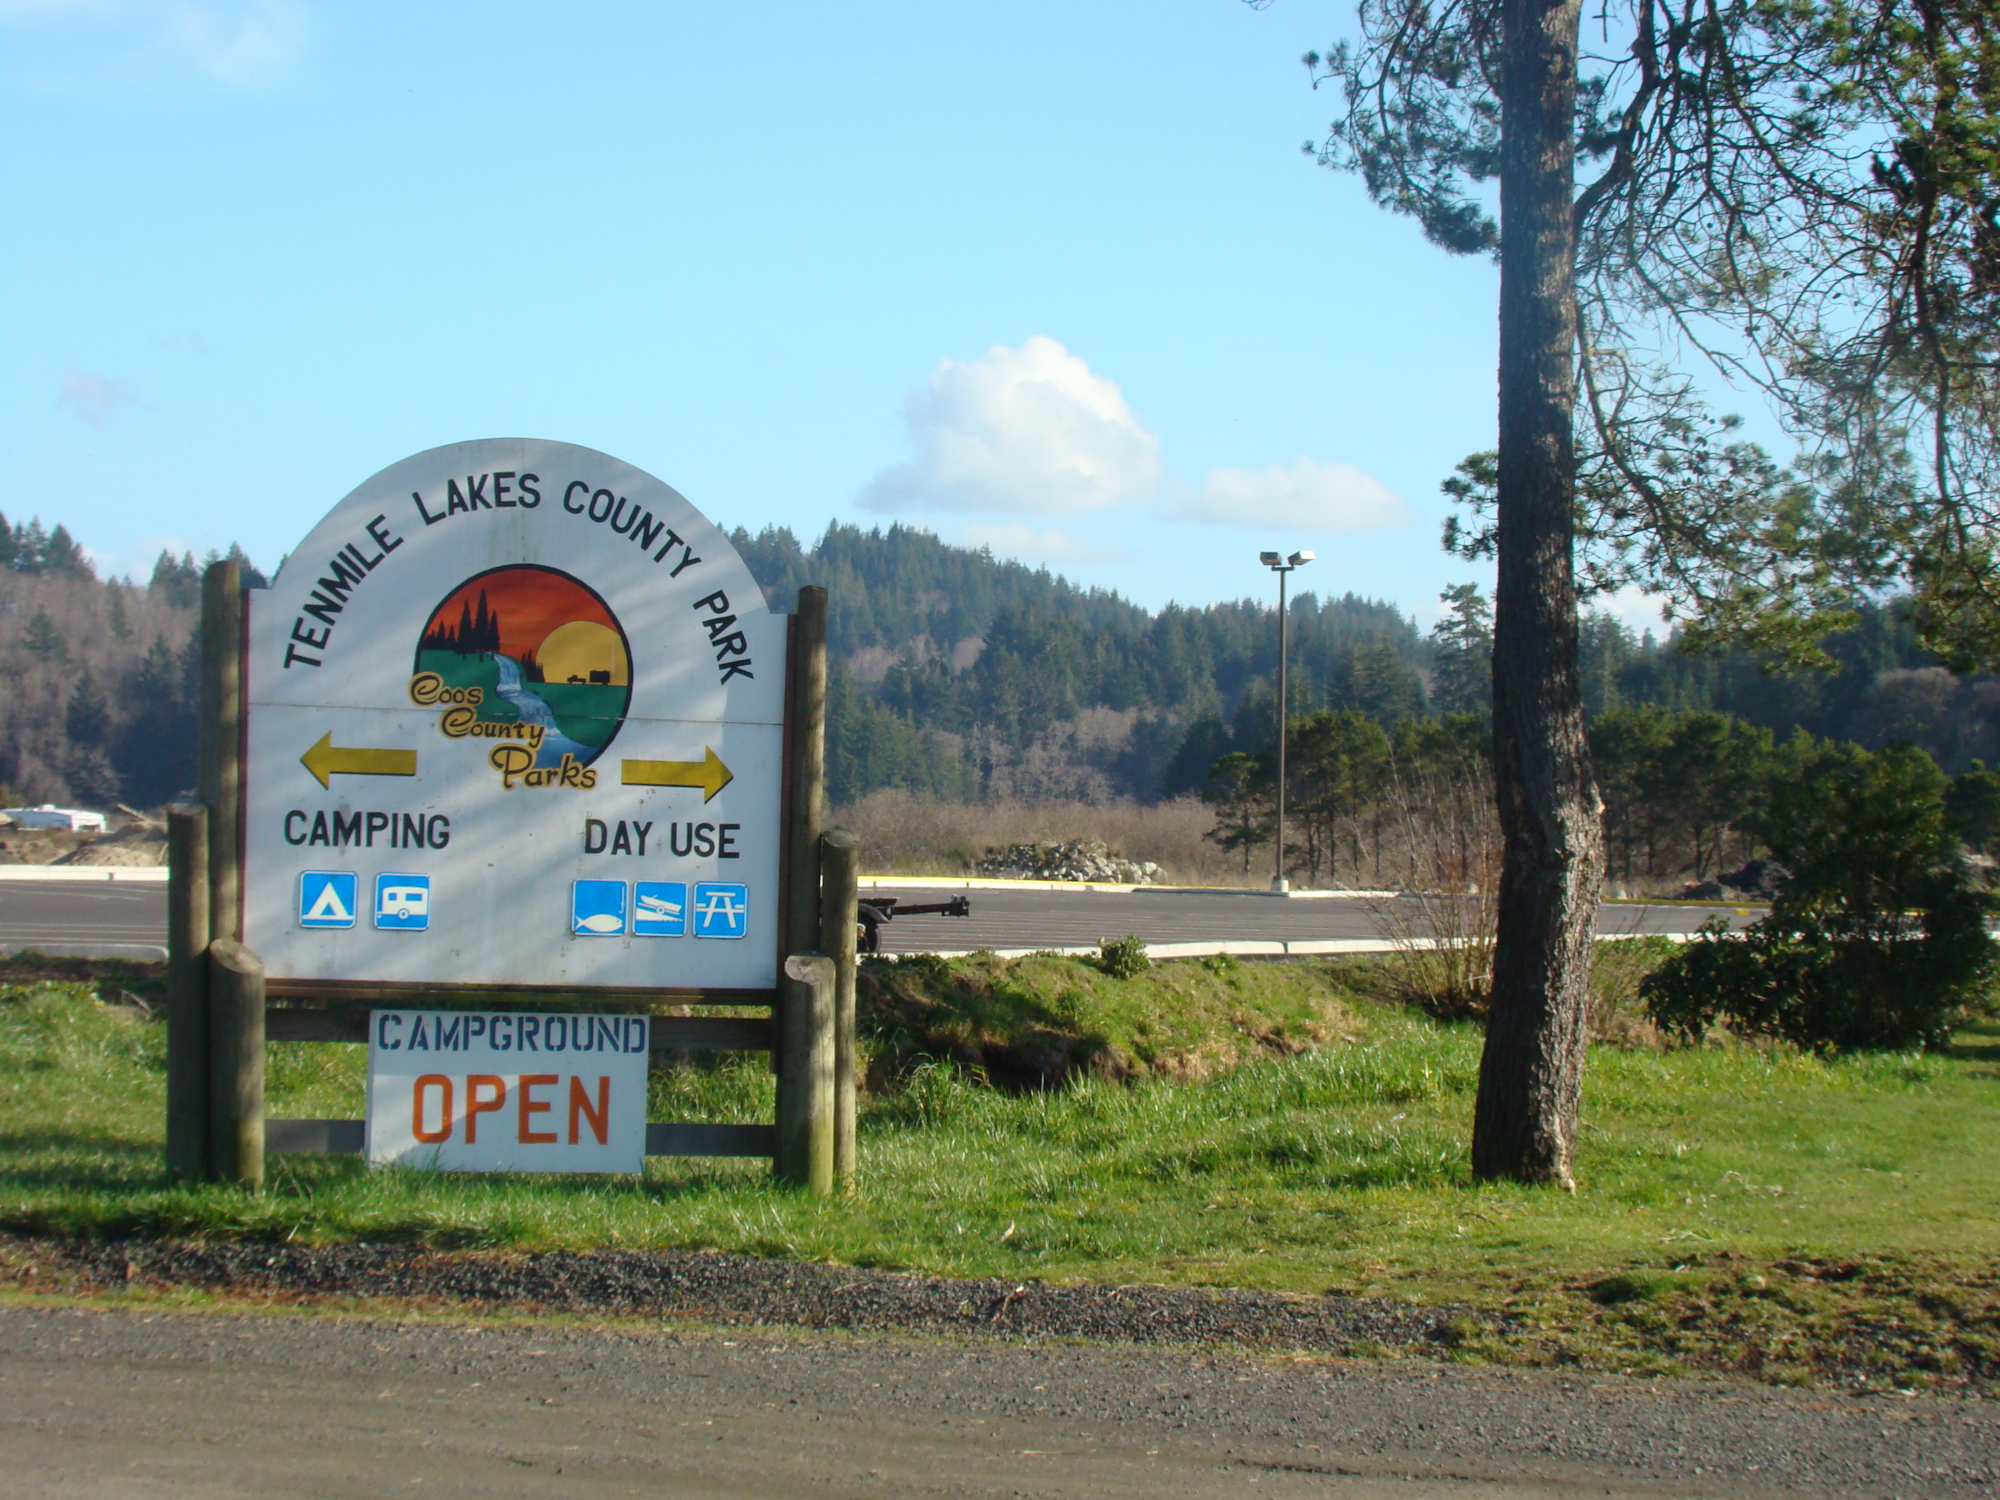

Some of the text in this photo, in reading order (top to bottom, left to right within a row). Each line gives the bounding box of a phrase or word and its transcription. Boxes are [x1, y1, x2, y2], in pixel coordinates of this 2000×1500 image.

[283, 471, 755, 686] TENMILE LAKES COUNTY PARK
[412, 674, 482, 705] Coos
[441, 708, 545, 747] County
[491, 746, 597, 790] Parks
[284, 810, 450, 850] CAMPING
[584, 820, 741, 859] DAY USE
[378, 1014, 646, 1054] CAMPGROUND
[412, 1074, 610, 1146] OPEN
